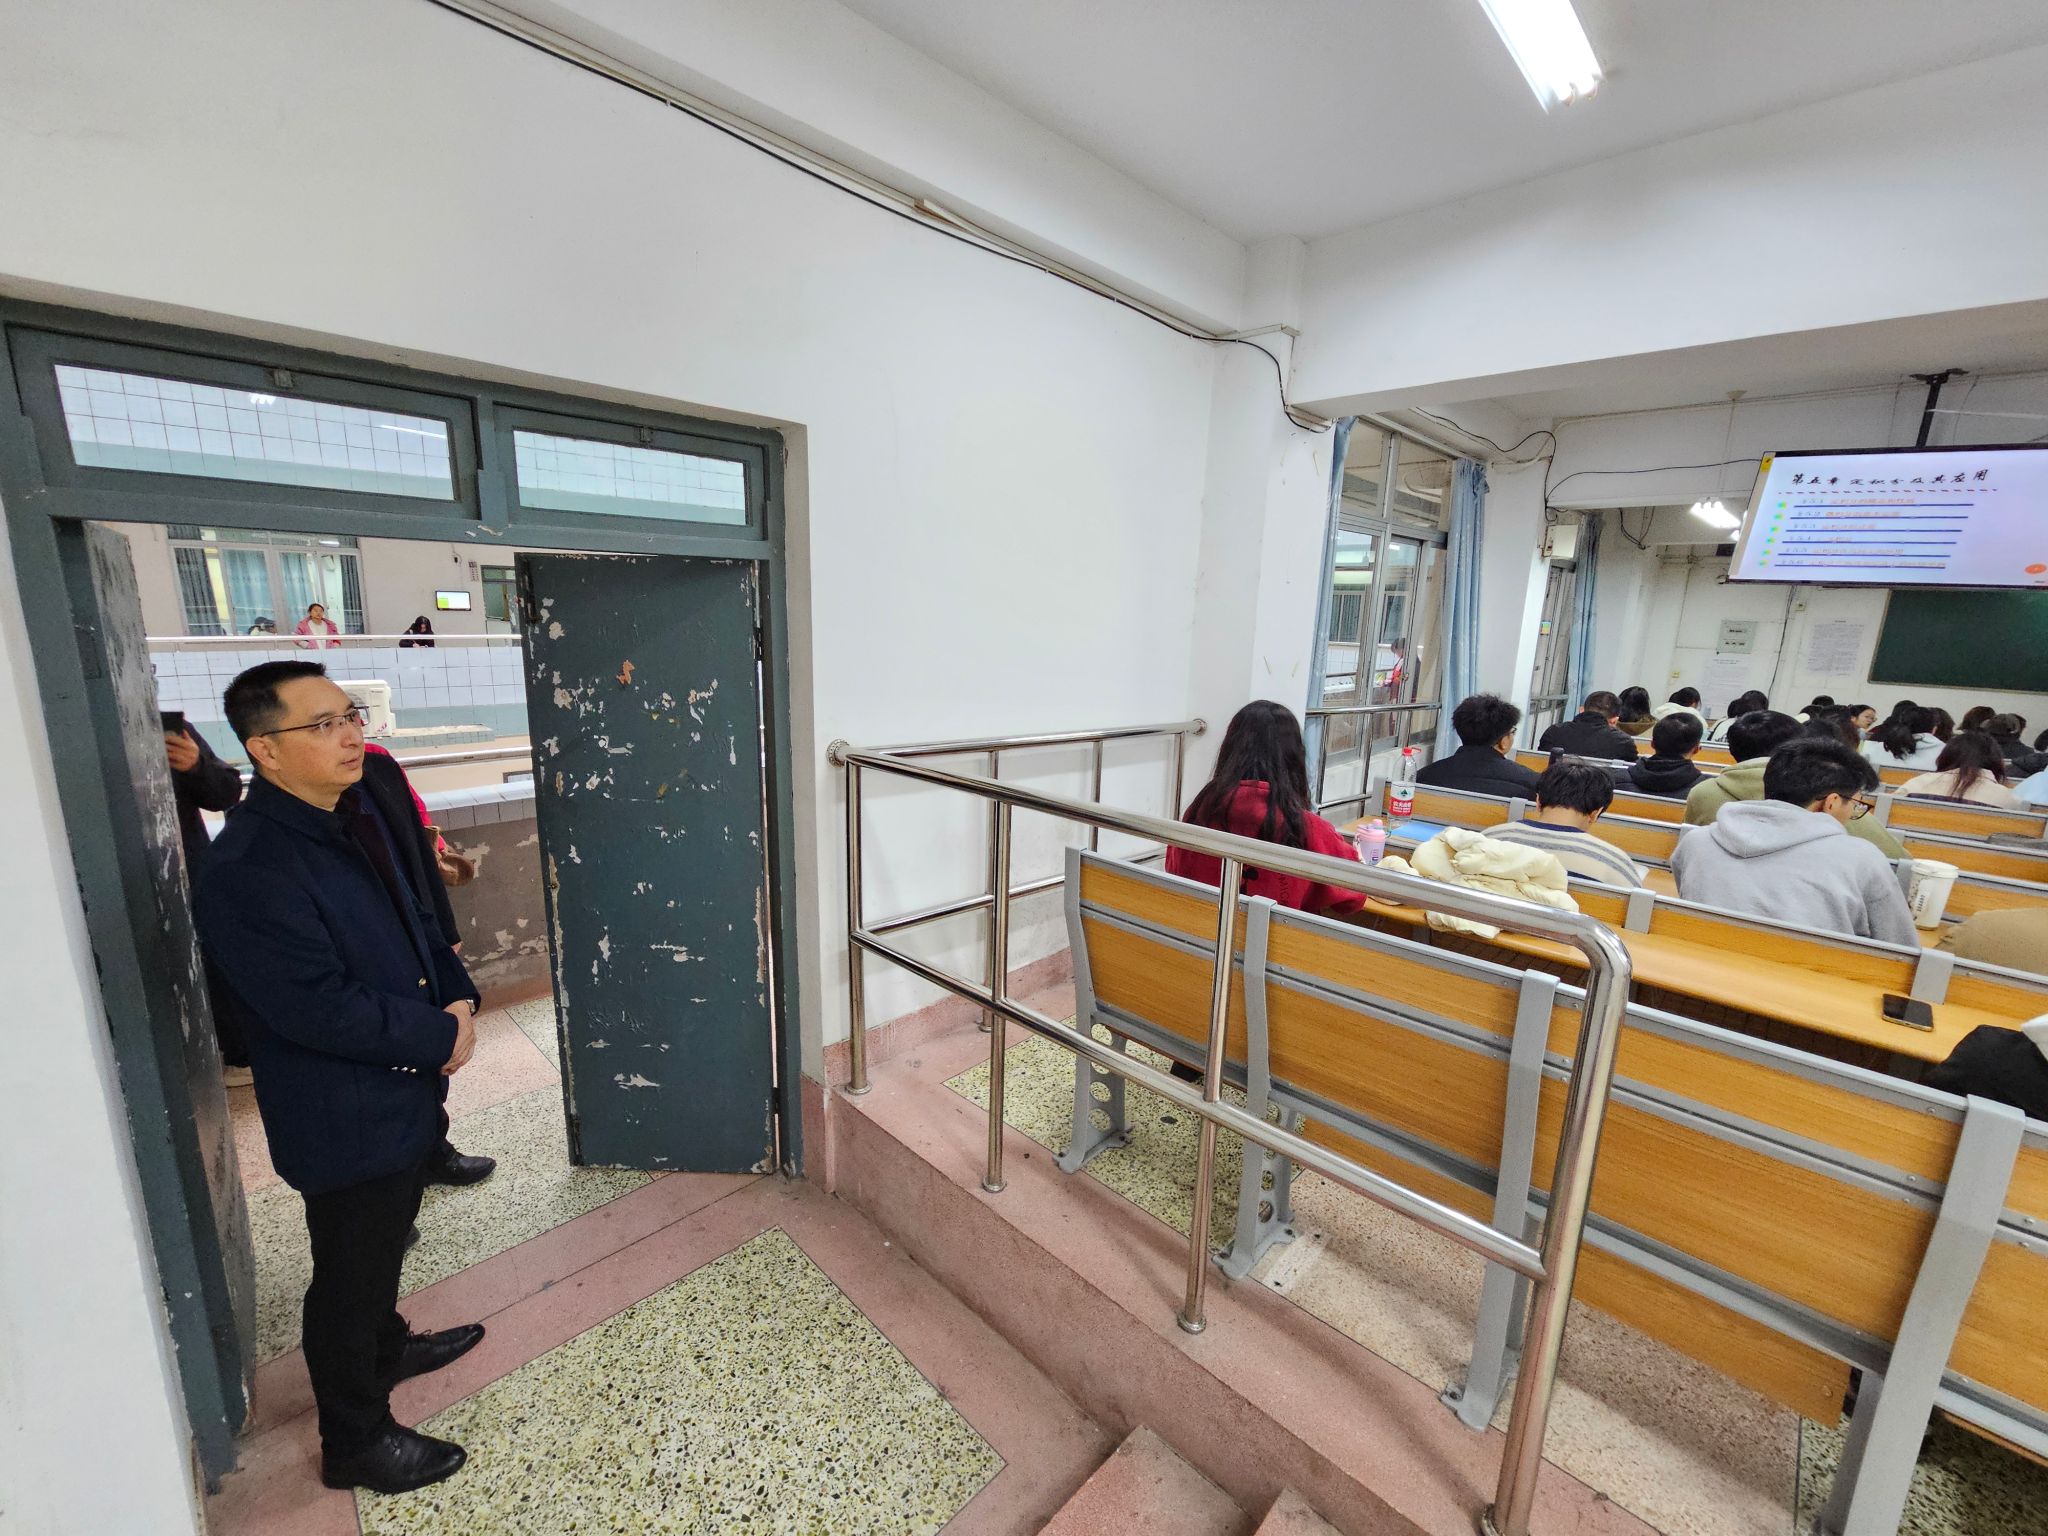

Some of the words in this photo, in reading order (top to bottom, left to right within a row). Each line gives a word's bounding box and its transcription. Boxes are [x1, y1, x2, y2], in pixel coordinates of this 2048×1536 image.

[1792, 473, 1839, 486] 第五章
[1850, 469, 1989, 486] 定积分及其应用
